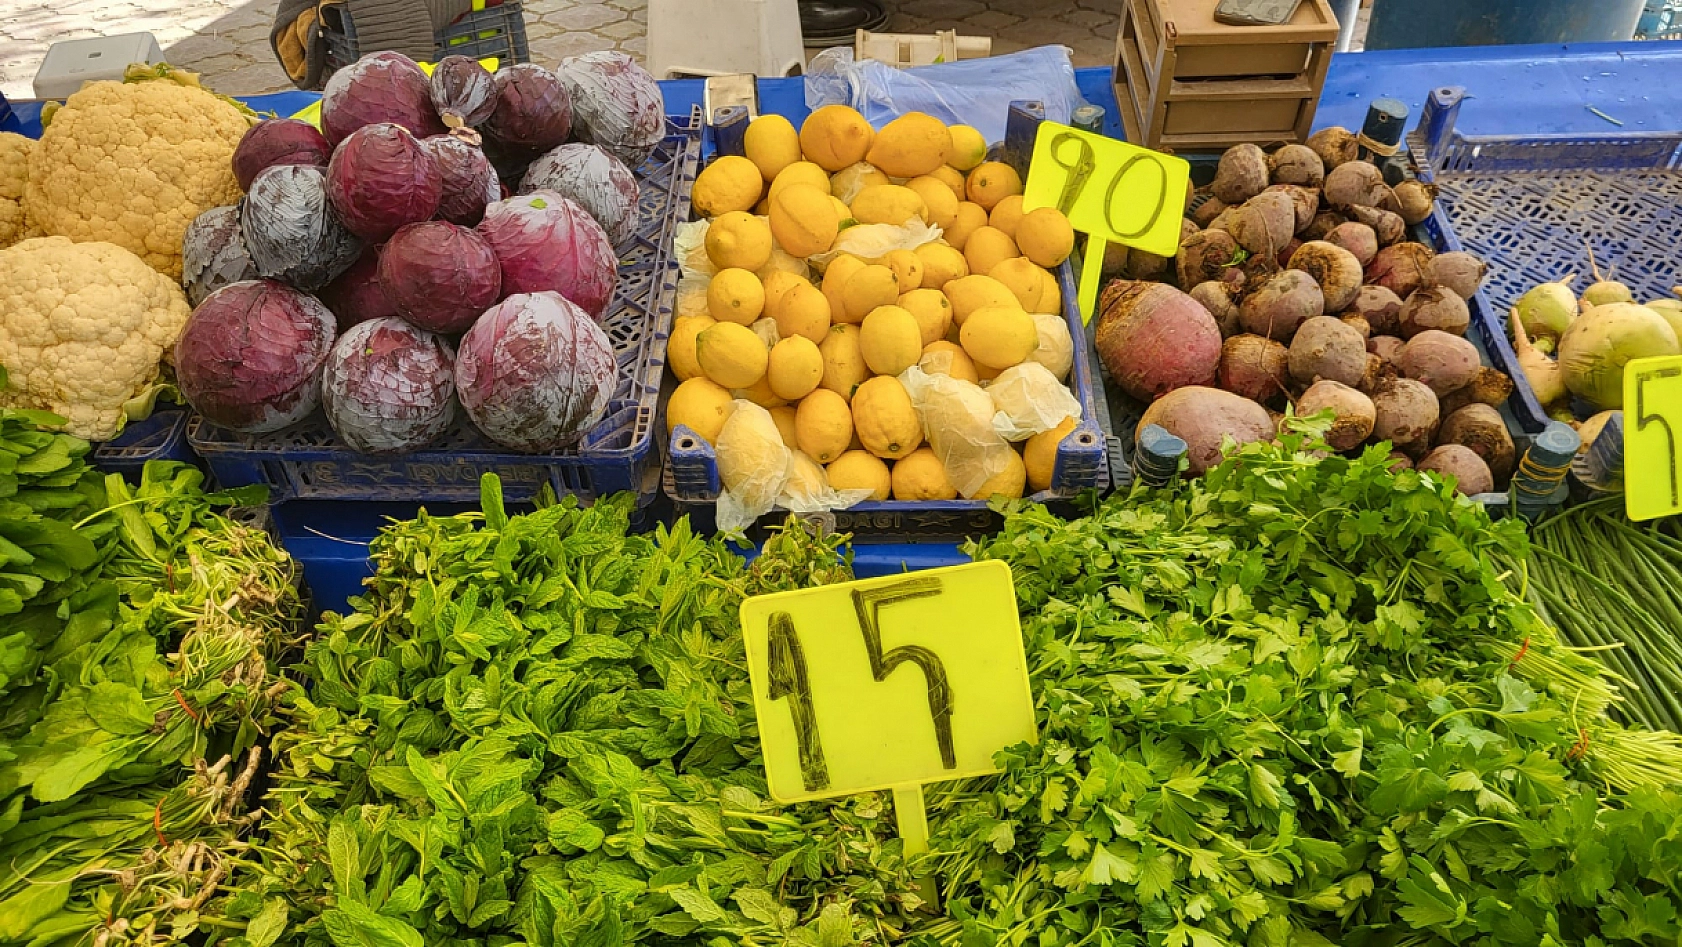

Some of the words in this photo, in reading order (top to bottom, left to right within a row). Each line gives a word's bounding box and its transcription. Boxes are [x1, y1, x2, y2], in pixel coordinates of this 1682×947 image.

[1050, 132, 1168, 240] 90
[1635, 367, 1682, 508] 5
[969, 512, 991, 528] 3
[766, 576, 957, 792] 15
